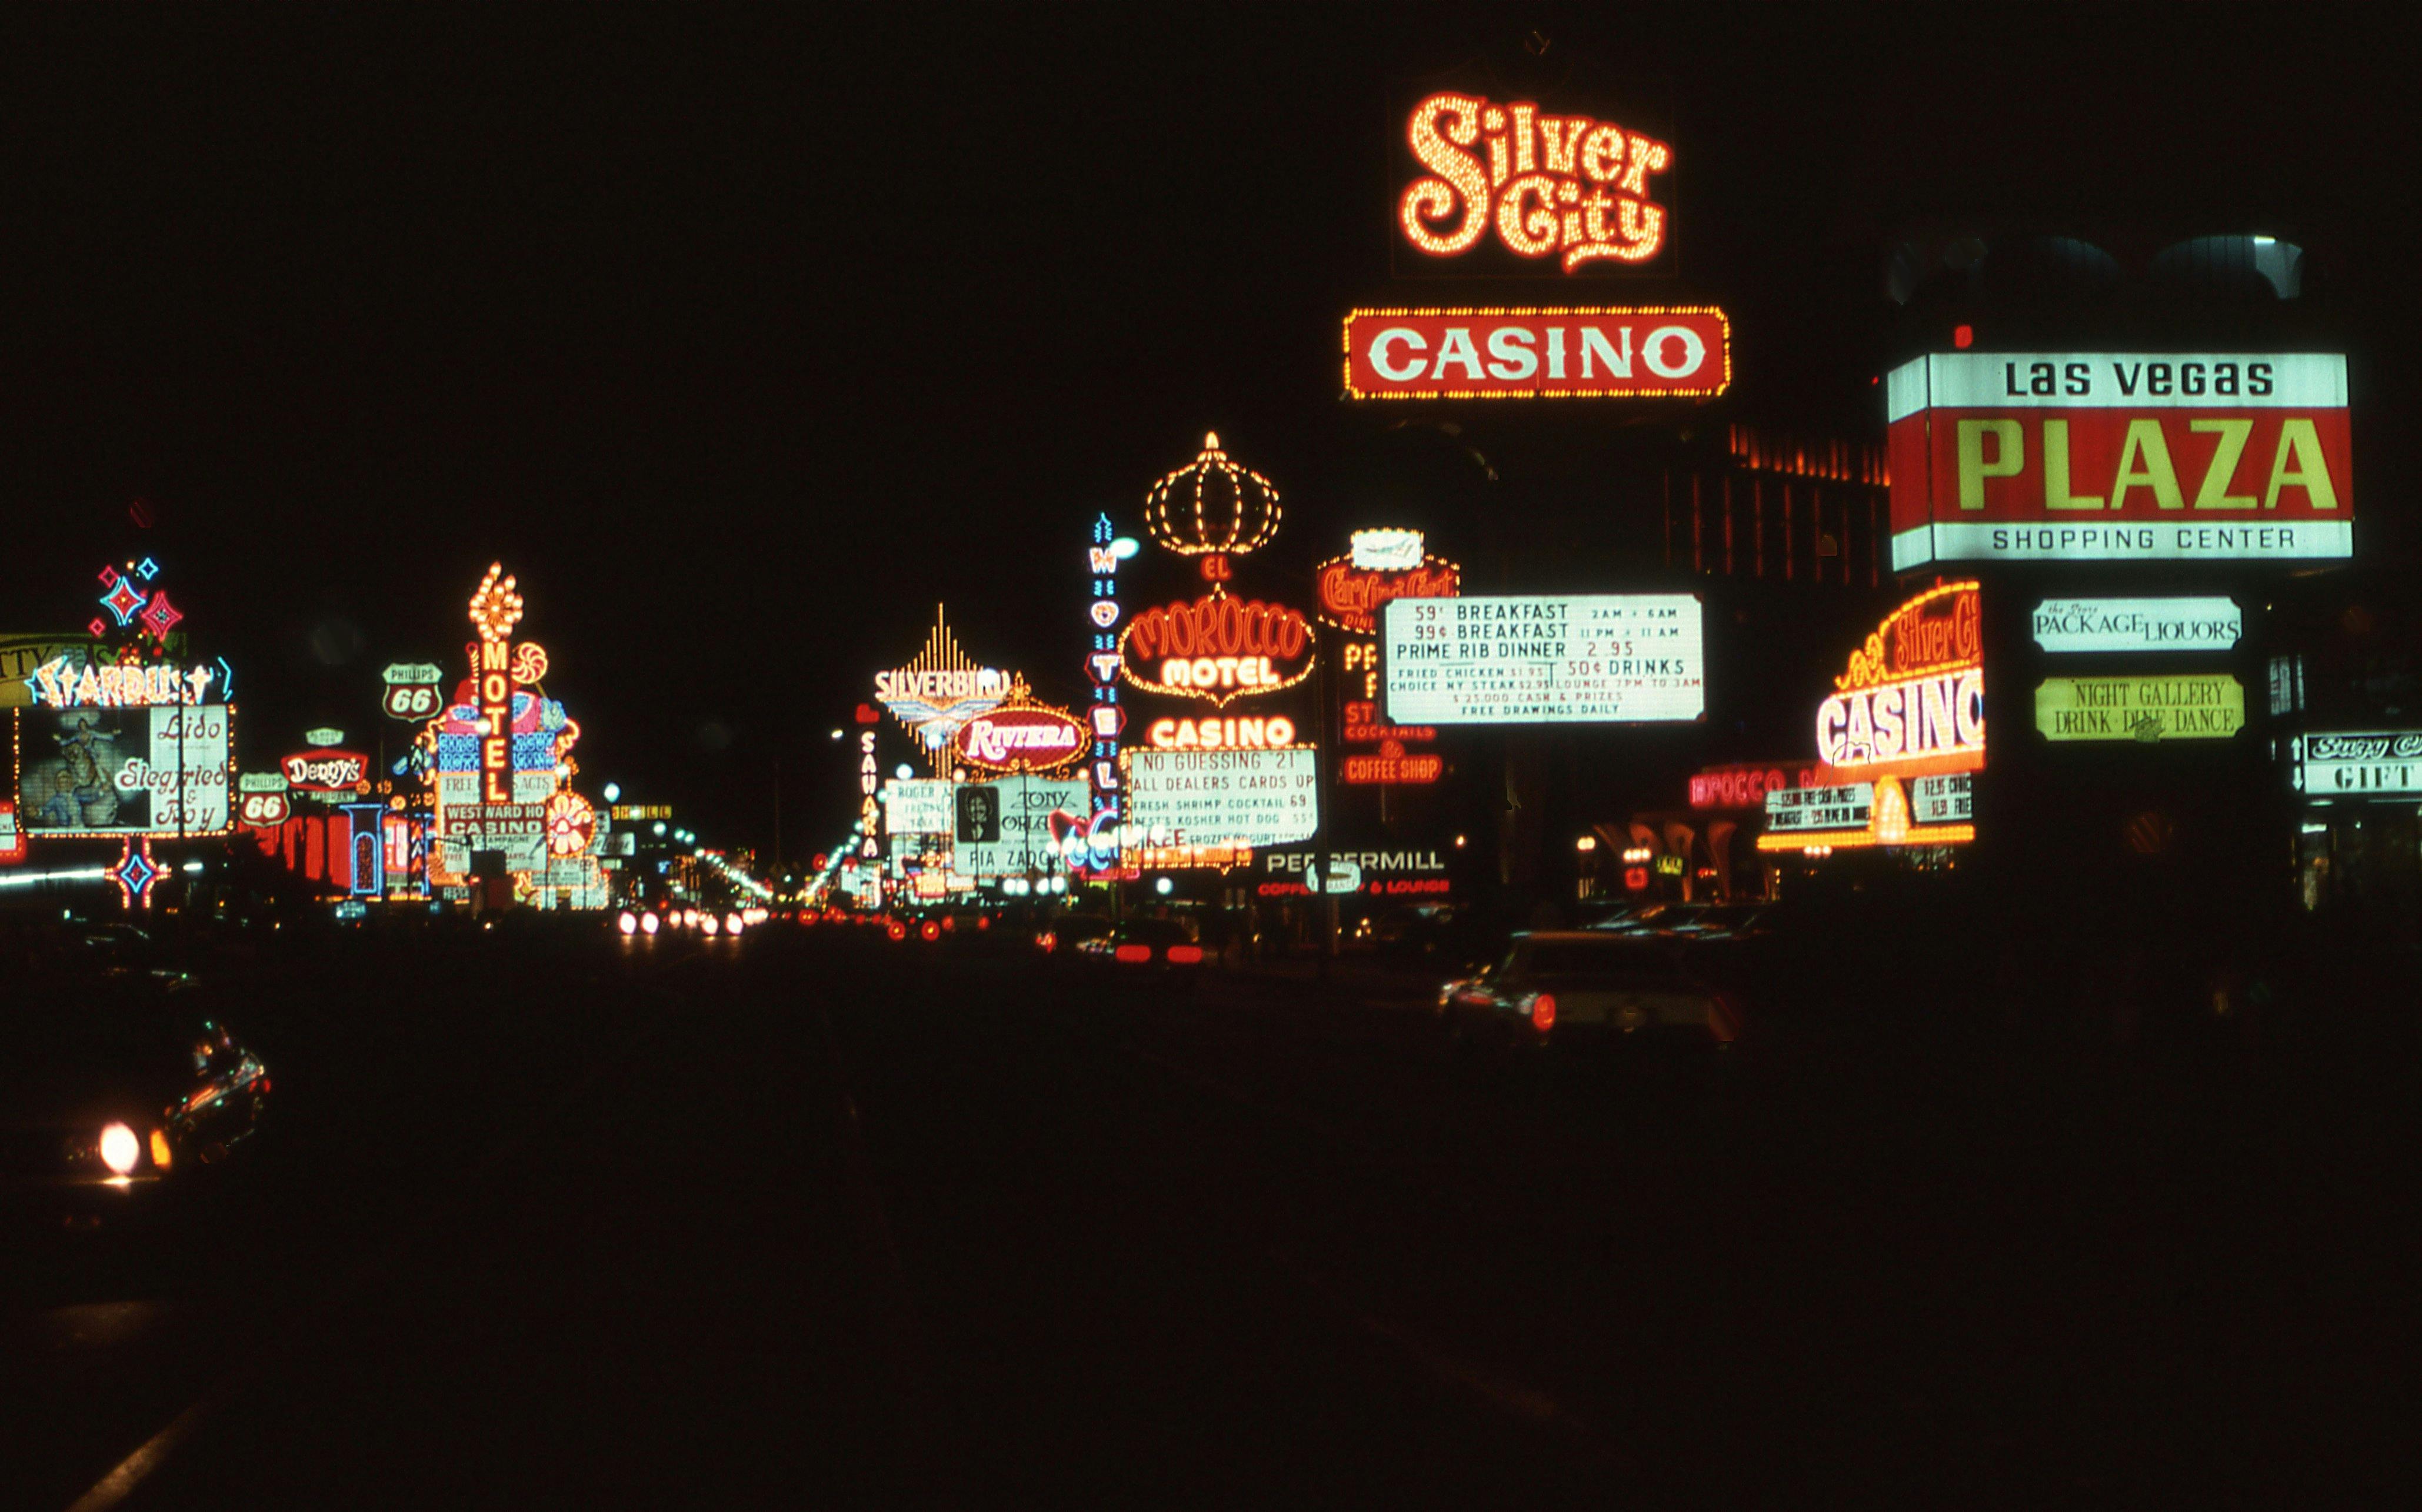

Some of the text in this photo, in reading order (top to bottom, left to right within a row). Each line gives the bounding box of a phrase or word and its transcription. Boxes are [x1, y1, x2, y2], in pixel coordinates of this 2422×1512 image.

[1399, 92, 1672, 256] Silver
[1495, 174, 1667, 274] City
[1368, 326, 1705, 381] CASINO
[2006, 363, 2090, 396] Las
[1957, 419, 2338, 509] PLAZA
[1994, 529, 2294, 549] SHOPPING CENTER
[1204, 556, 1231, 578] EL
[1457, 604, 1567, 619] BREAKFAST
[1134, 598, 1302, 659] MOROCCO
[1458, 623, 1568, 639] BREAKFAST
[2036, 613, 2144, 633] PACKAGE
[2146, 621, 2240, 641] LIQUORS
[1397, 642, 1565, 659] PRIME RIB DINNER
[1897, 609, 1953, 671] Silver
[392, 669, 434, 680] PHILLIPS
[1090, 548, 1121, 788] MOTEL
[1162, 657, 1280, 687] MOTEL
[1398, 668, 1437, 678] FRIED
[1445, 667, 1504, 677] CHICKEN
[1568, 659, 1684, 675] 50¢ DRINKS
[35, 655, 215, 706] STARDUST
[1390, 681, 1437, 692] CHOICE
[1473, 680, 1515, 690] STEAK
[1556, 679, 1606, 690] LOUNGE
[391, 689, 431, 712] 66
[1518, 693, 1550, 702] CASH
[2076, 682, 2225, 707] NIGHT GALLERY
[482, 641, 508, 800] MOTEL
[1462, 704, 1620, 716] FREE DRAWINGS DAILY
[1817, 675, 1984, 765] CASINO
[2056, 710, 2111, 733] DRINK
[2176, 708, 2235, 732] DANCE
[158, 714, 220, 739] Lido
[1150, 717, 1294, 747] CASINO
[1345, 725, 1435, 739] COCKTAILS
[287, 757, 361, 788] Denny's
[1144, 754, 1164, 771] NO
[1175, 753, 1261, 771] GUESSING
[1348, 758, 1438, 779] COFFEE SHOP
[1134, 775, 1314, 791] ALL DEALERS CARDS UP
[2334, 765, 2414, 790] GIFT
[245, 796, 281, 819] 66
[525, 805, 545, 818] HO
[1134, 800, 1169, 811] FRESH
[1177, 799, 1221, 810] SHRIMP
[1228, 799, 1284, 809] COCKTAIL
[450, 821, 542, 835] CASINO
[1178, 815, 1221, 825] KOSHER
[1228, 815, 1250, 824] HOT
[1257, 814, 1280, 823] DOG
